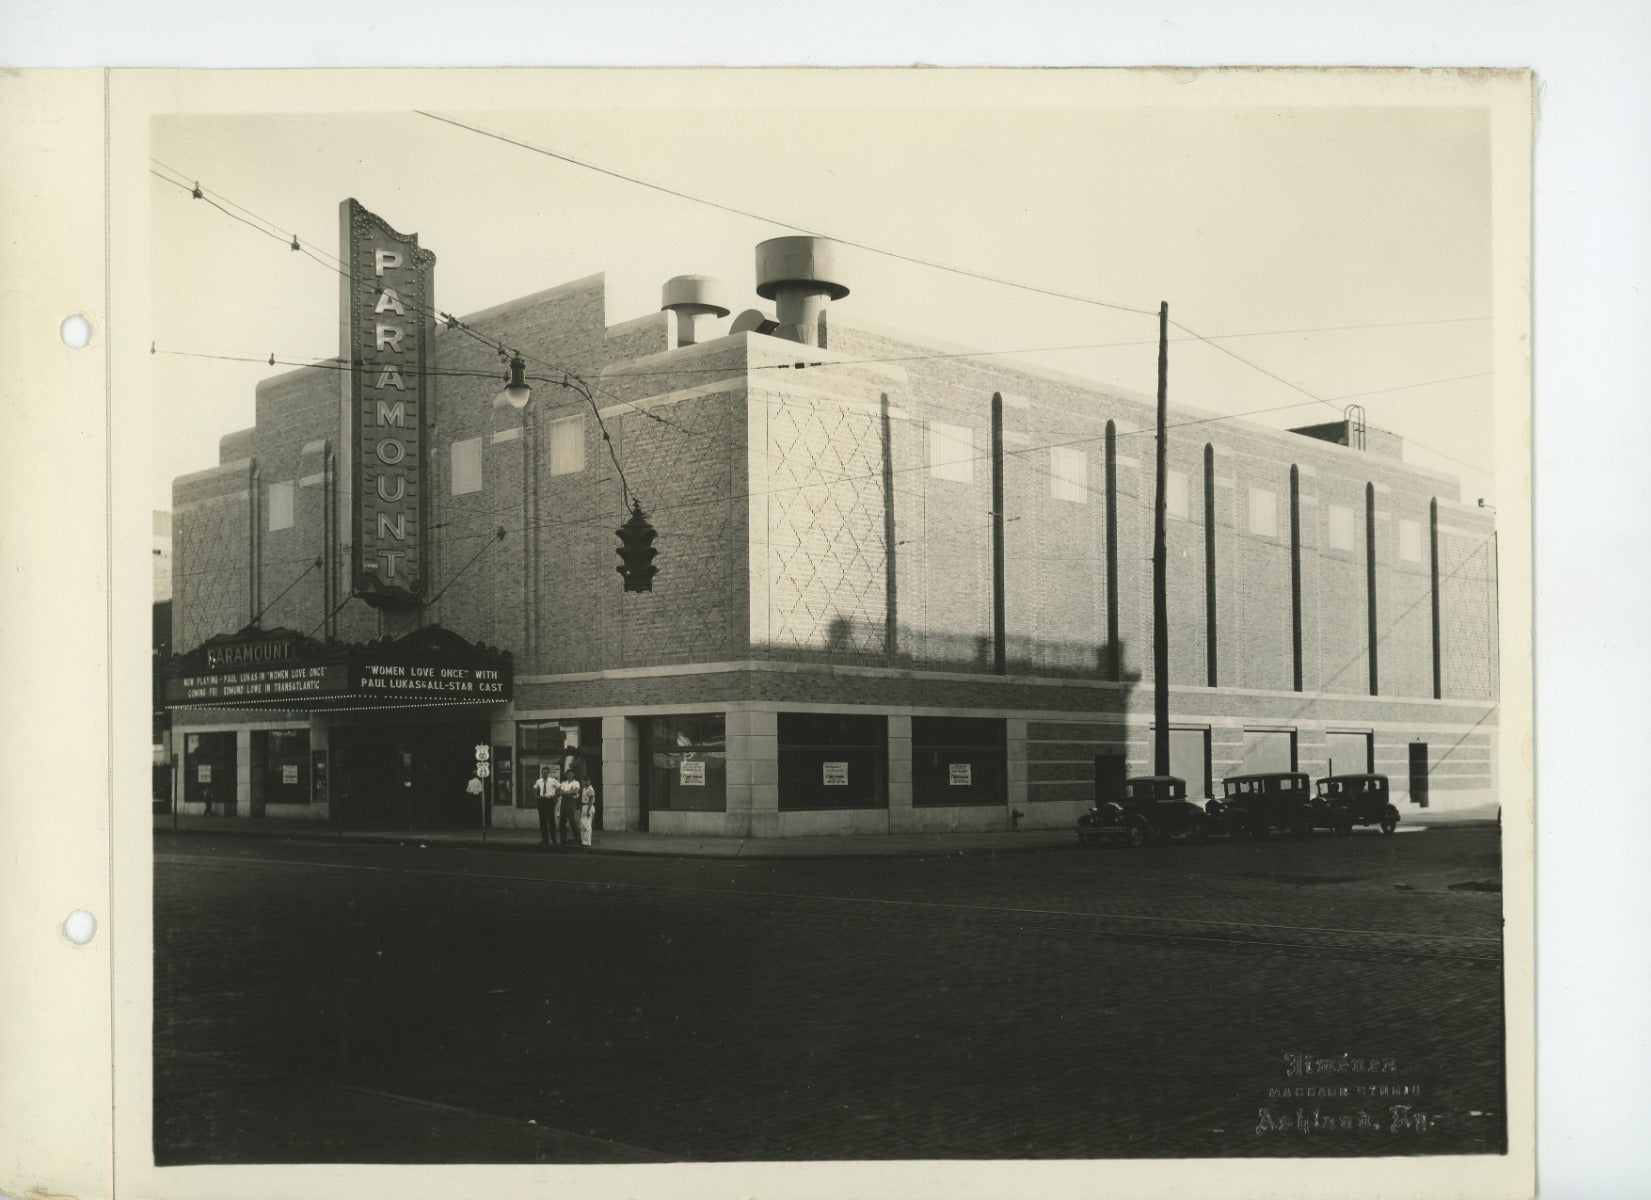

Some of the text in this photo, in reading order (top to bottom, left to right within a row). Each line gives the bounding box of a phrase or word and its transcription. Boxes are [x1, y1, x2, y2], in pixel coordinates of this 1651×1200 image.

[374, 249, 405, 578] PARAMOUNT
[207, 642, 291, 666] PARAMOUNT
[183, 677, 195, 687] NOW
[197, 675, 219, 686] PLAYING
[223, 673, 237, 684] PAUL
[240, 672, 258, 682] LUKAS
[291, 668, 306, 679] LOVE
[411, 667, 435, 677] LOVE
[475, 670, 498, 680] WITH
[188, 688, 206, 699] COMING
[223, 685, 244, 696] EDMUND
[246, 683, 262, 694] LOWE
[264, 683, 271, 693] IN
[274, 680, 320, 693] TRANSATLANTIC
[360, 678, 387, 689] PAUL
[479, 682, 504, 692] CAST
